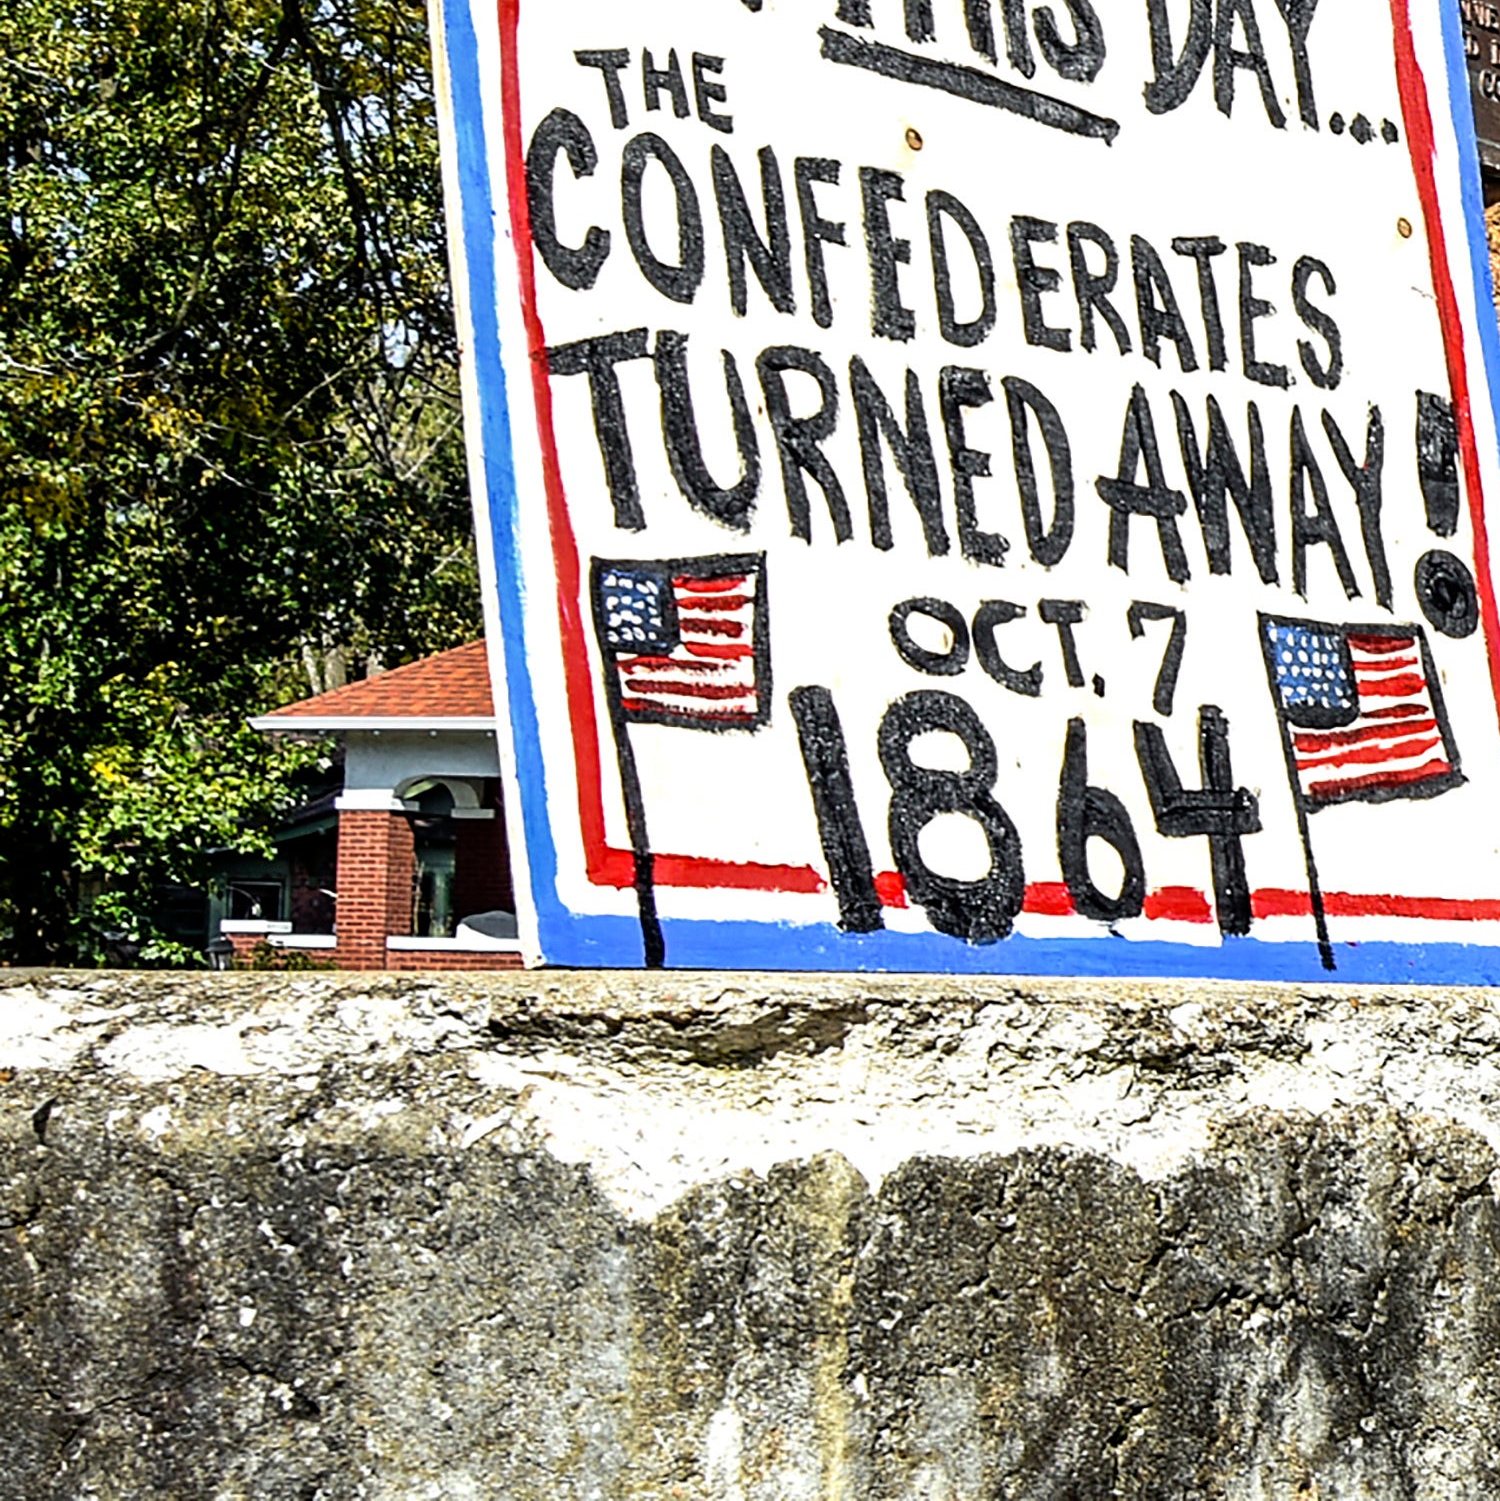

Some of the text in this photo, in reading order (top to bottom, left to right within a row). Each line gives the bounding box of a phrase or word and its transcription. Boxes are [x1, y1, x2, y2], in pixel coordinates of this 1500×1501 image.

[573, 47, 734, 133] THE
[525, 108, 1343, 390] CONFEDERATES
[538, 327, 1480, 638] TURNED AWAY!
[788, 686, 1263, 945] 1864
